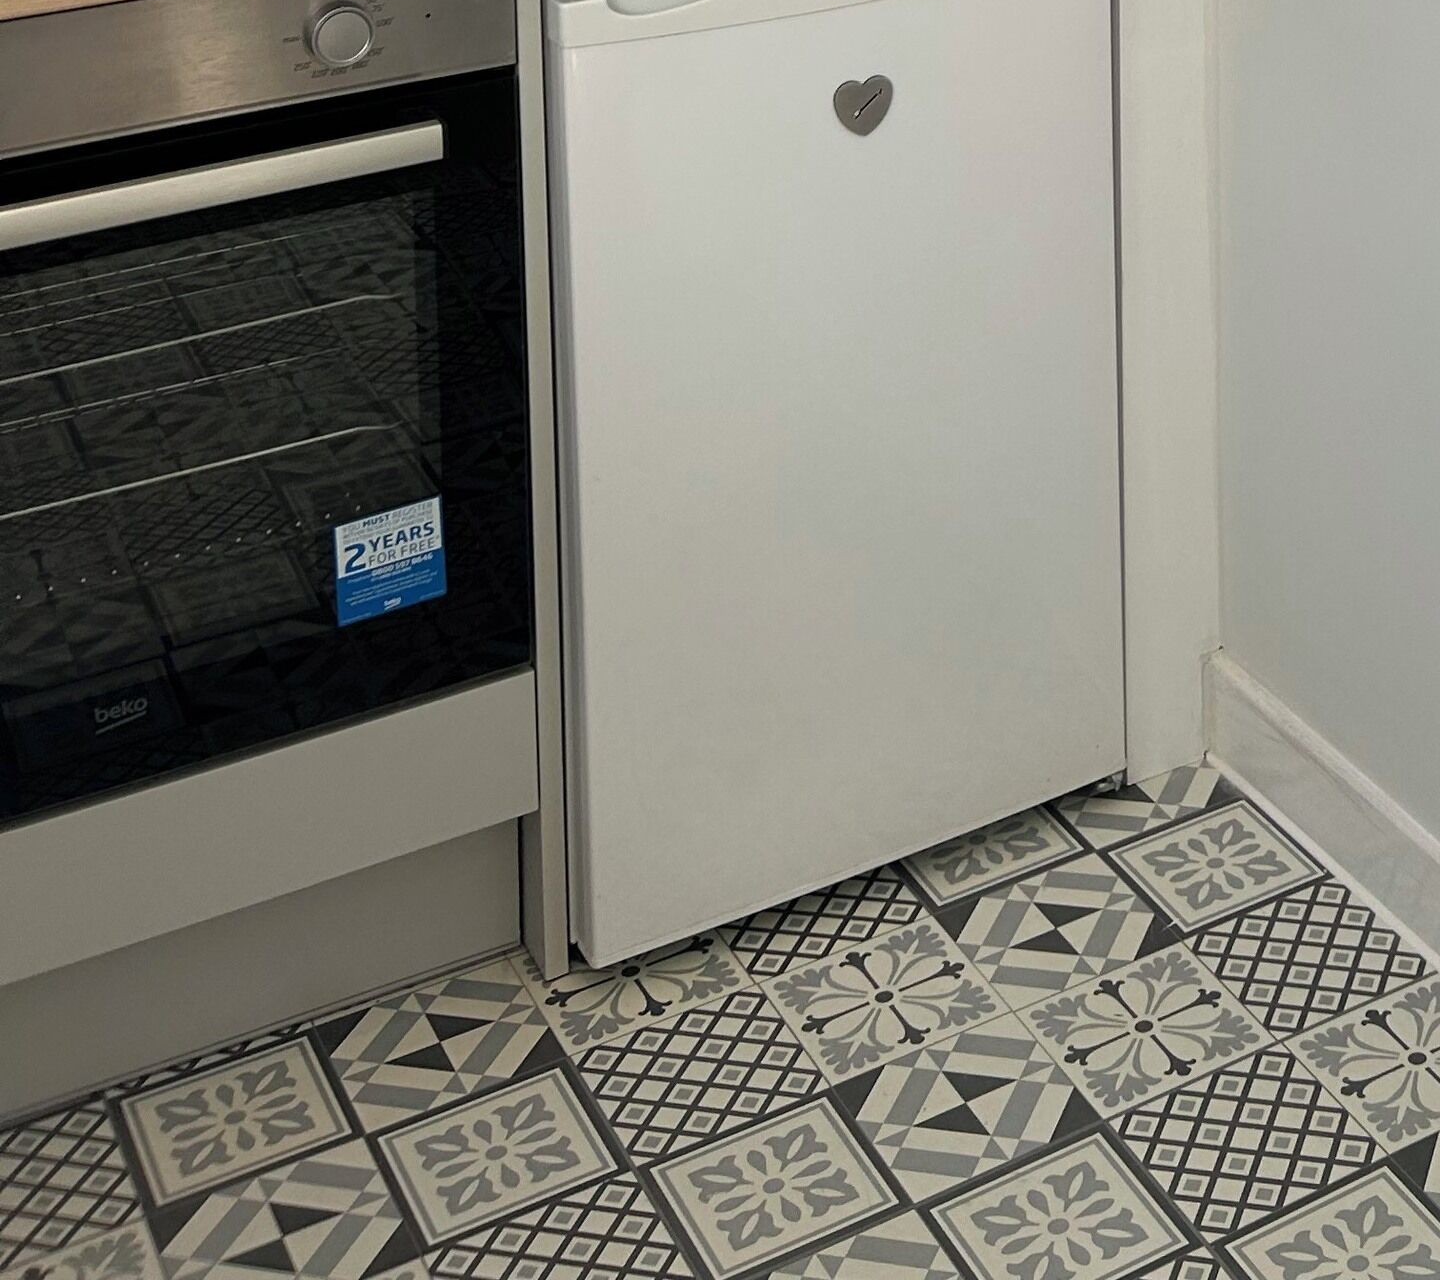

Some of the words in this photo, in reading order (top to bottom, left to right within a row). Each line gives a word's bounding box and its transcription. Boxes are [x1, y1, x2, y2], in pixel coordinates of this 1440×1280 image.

[362, 514, 390, 528] MUST
[344, 542, 367, 574] 2
[368, 520, 434, 553] YEARS
[368, 549, 397, 568] FOR
[400, 538, 435, 558] FREE
[93, 697, 148, 723] beko
